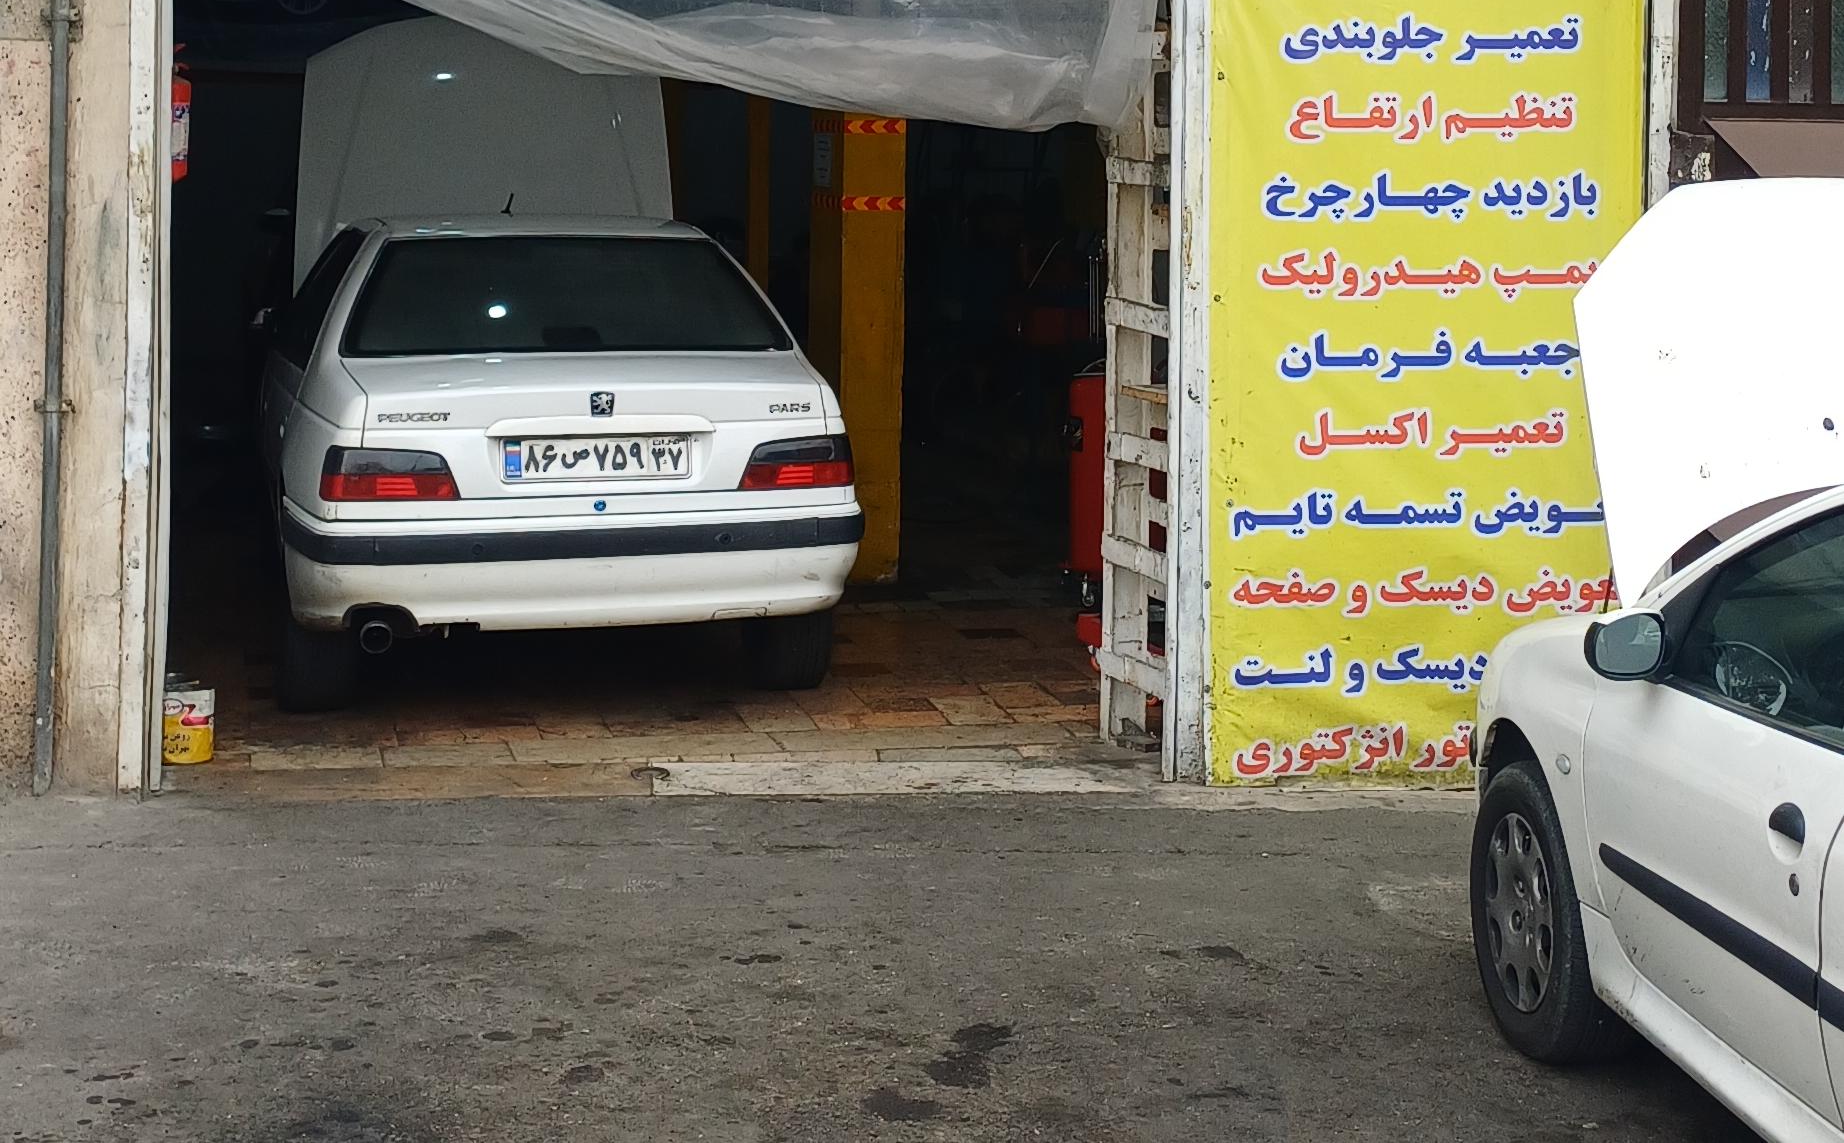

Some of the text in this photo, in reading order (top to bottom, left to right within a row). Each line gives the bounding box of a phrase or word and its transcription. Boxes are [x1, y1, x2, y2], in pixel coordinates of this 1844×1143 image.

[1283, 15, 1580, 61] تعمیر جلوبندی
[1289, 95, 1575, 140] تنظیم ارتفاع
[1483, 172, 1598, 218] بازدید
[1261, 251, 1481, 296] هیدرولیک
[1280, 330, 1581, 378] جعبه فرمان
[377, 411, 451, 424] PEUGEOT
[768, 402, 812, 415] PARS
[1299, 411, 1566, 456] تعمیر اکسل
[1232, 491, 1333, 537] تایم
[1344, 491, 1463, 526] تسمه
[1233, 571, 1336, 605] صفحه
[1346, 583, 1369, 615] و
[1380, 570, 1494, 611] دیسک
[1233, 646, 1333, 688] لنت
[1344, 660, 1366, 694] و
[1236, 726, 1405, 776] انژکتوری
